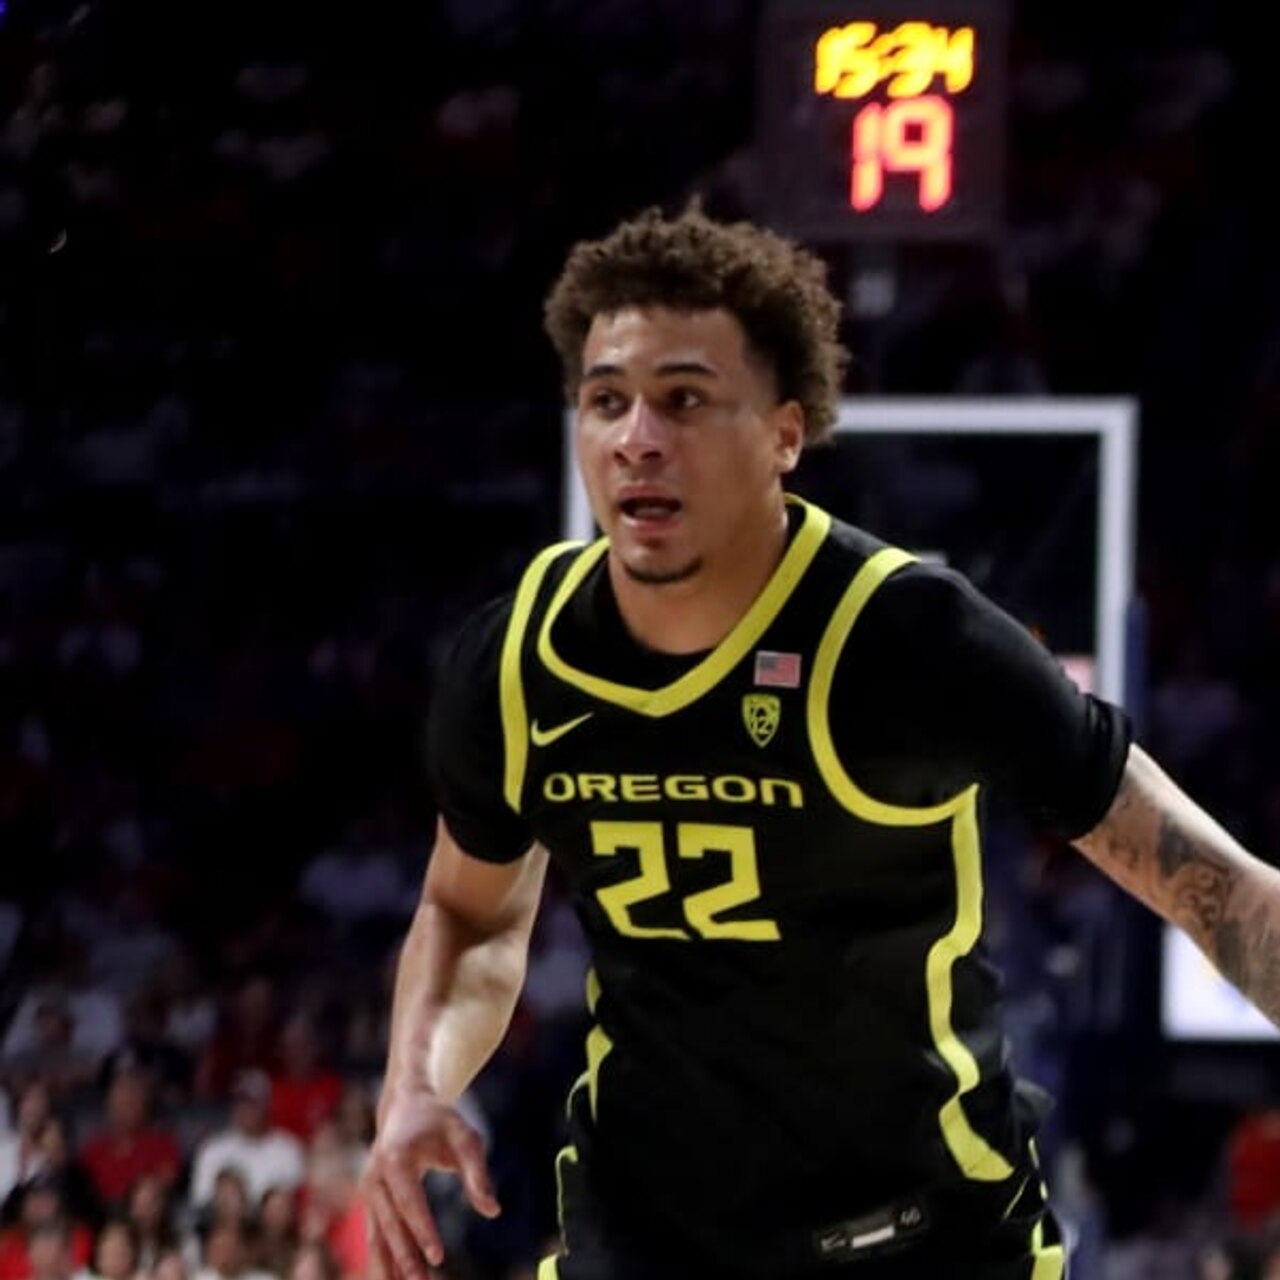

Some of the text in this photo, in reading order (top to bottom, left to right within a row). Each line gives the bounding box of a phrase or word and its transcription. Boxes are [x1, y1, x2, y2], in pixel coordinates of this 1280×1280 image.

[850, 95, 953, 212] 19
[543, 773, 803, 807] OREGON
[590, 820, 781, 940] 22
